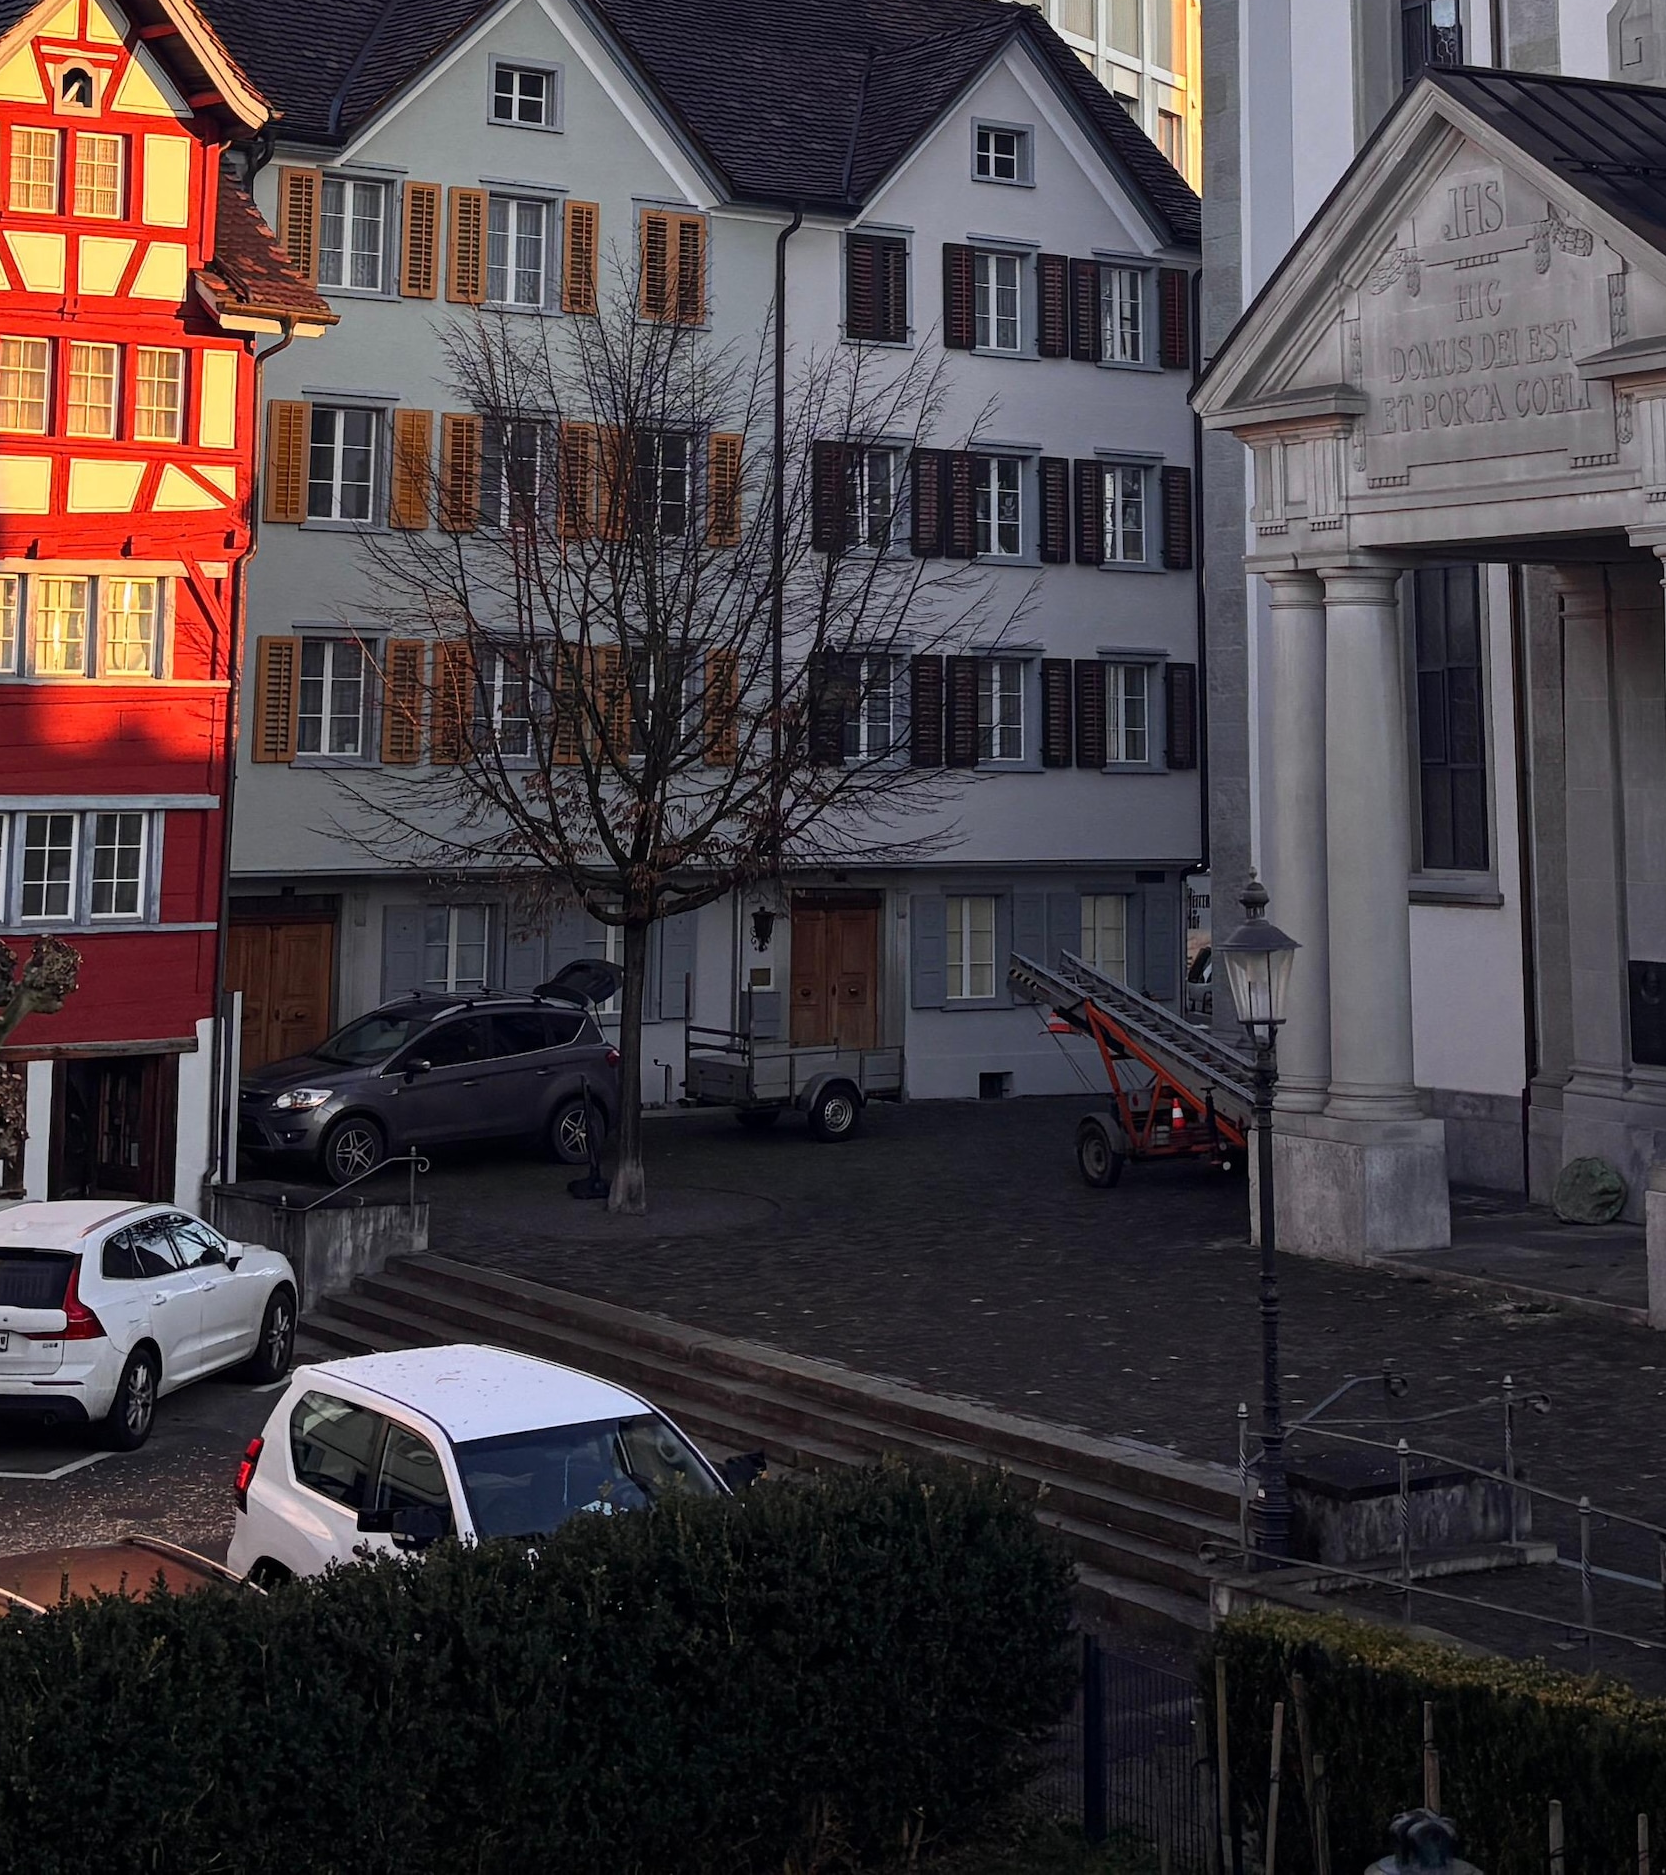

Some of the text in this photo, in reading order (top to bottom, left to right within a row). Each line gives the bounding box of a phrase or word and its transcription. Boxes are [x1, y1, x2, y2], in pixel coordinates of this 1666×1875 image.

[1455, 279, 1503, 323] HIC
[1389, 318, 1578, 384] DOMUS DEI EST
[1381, 372, 1592, 435] ET PORTA COELI
